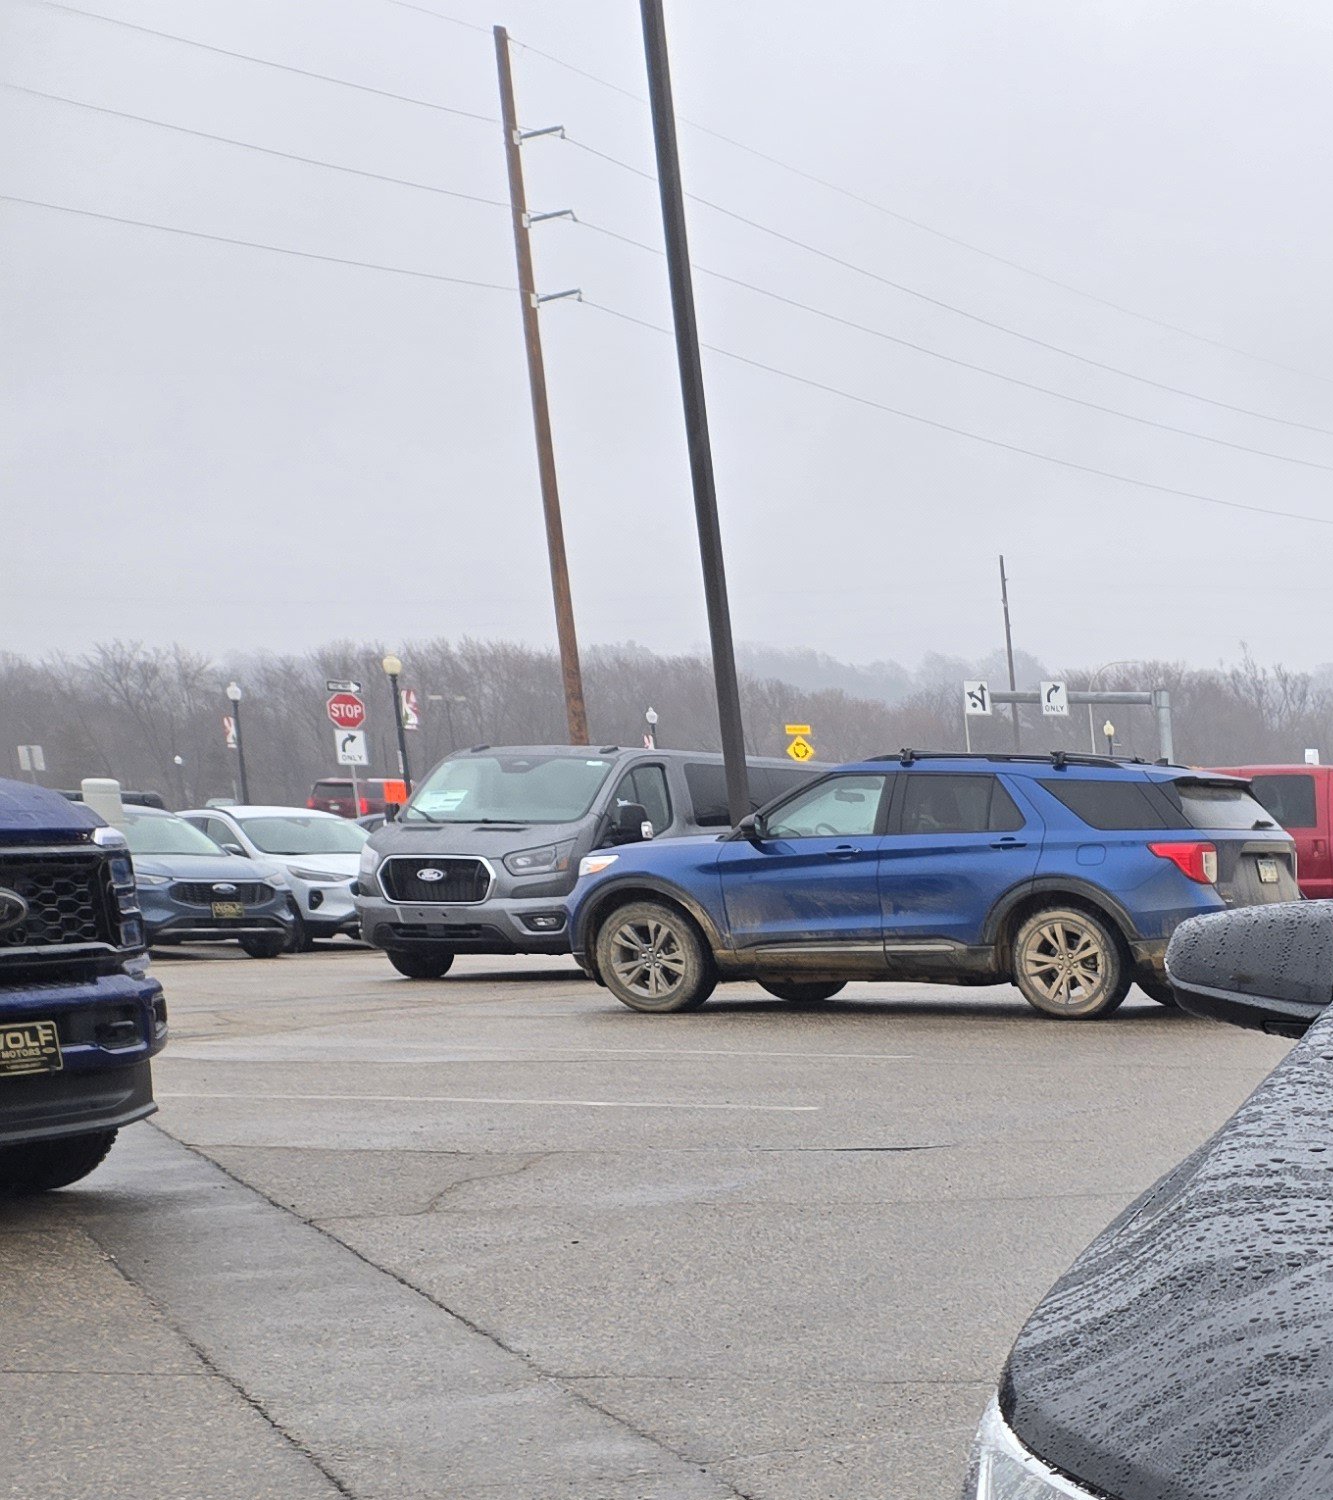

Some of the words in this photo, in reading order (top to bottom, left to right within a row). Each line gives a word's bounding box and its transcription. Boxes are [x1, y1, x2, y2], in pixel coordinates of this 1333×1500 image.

[331, 703, 362, 719] STOP
[1044, 705, 1065, 713] ONLY
[341, 753, 363, 763] ONLY
[0, 1028, 54, 1050] OLF
[1, 1047, 41, 1059] MOTORS
